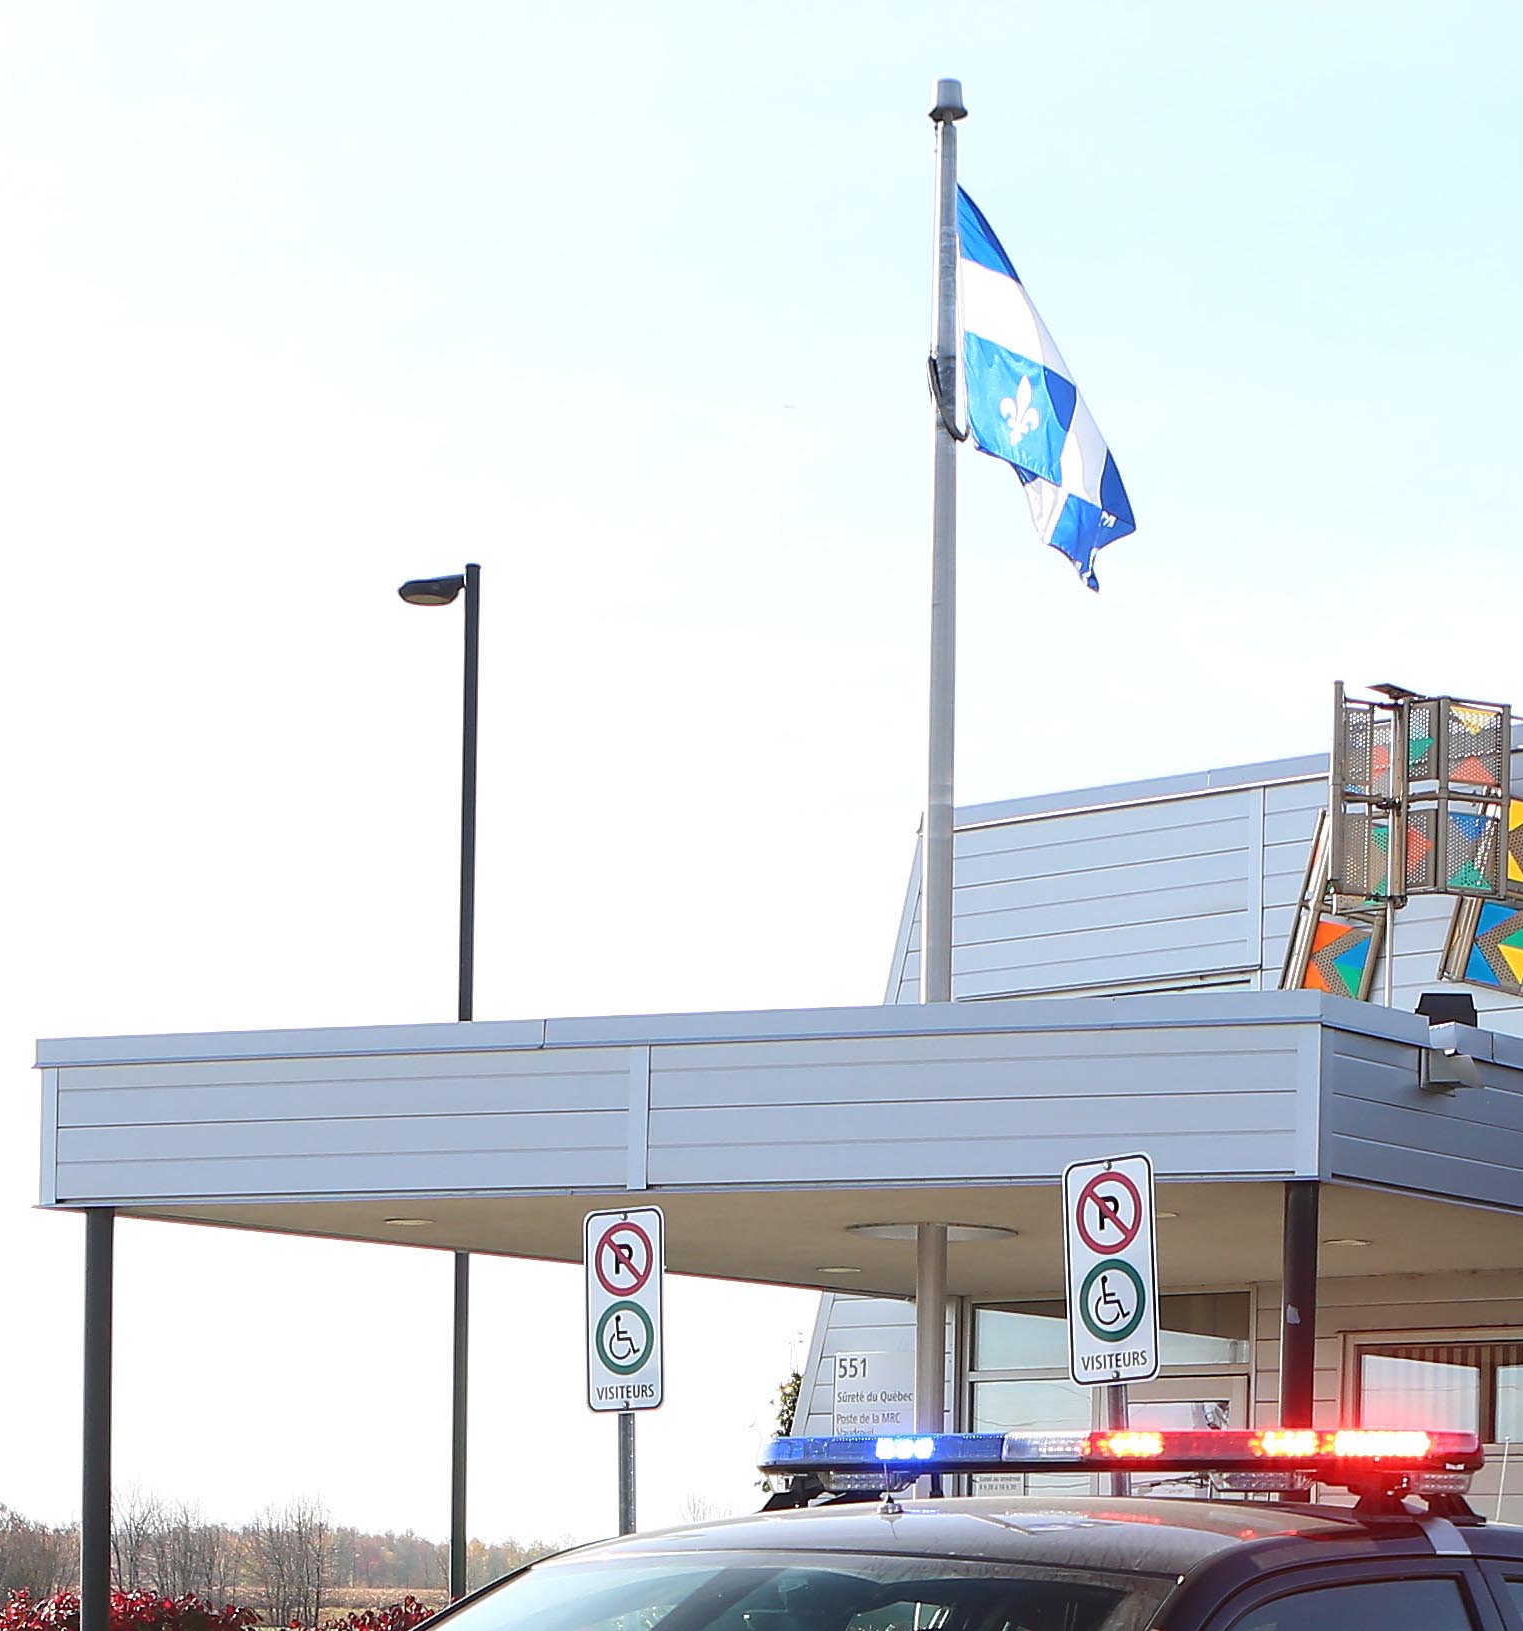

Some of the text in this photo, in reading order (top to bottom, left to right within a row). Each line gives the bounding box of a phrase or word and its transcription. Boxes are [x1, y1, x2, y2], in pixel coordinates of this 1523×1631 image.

[838, 1357, 867, 1379] 551
[1080, 1350, 1148, 1371] VISITEURS
[596, 1383, 655, 1401] VISITEURS
[866, 1391, 878, 1402] du
[880, 1390, 913, 1403] Québec
[836, 1411, 901, 1425] Poste de la MRC
